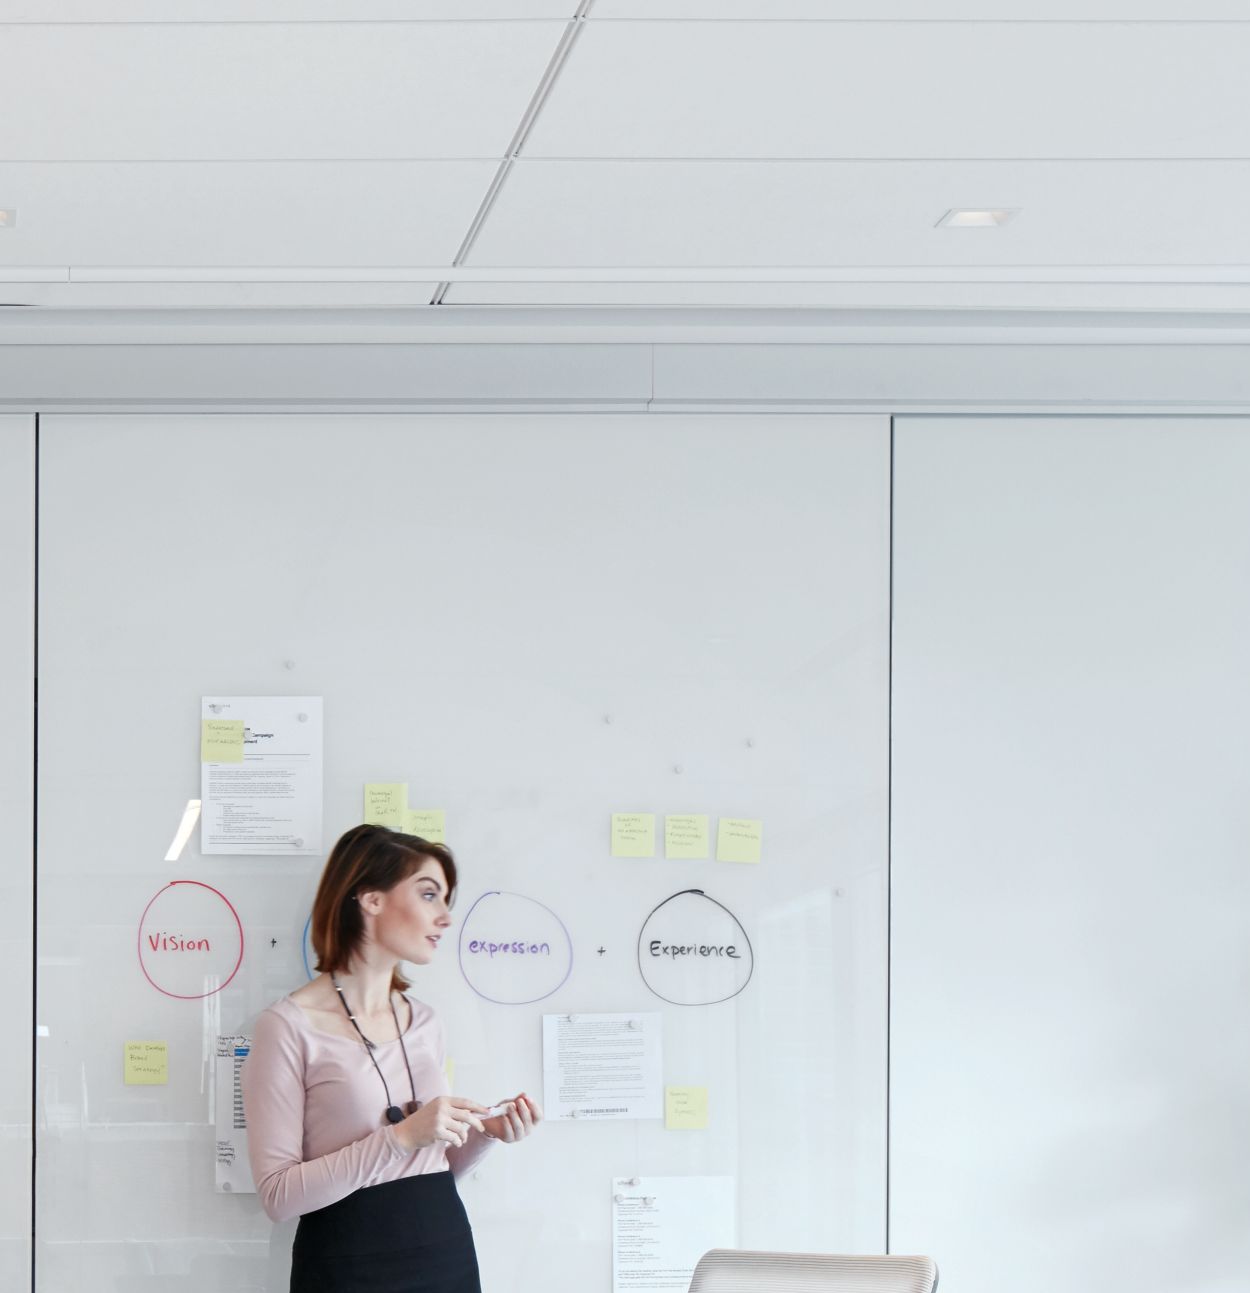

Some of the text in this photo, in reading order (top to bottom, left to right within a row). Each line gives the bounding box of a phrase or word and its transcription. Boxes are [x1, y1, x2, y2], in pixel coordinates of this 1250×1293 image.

[149, 931, 211, 952] Vision
[468, 939, 550, 958] expression
[649, 940, 742, 959] Experience
